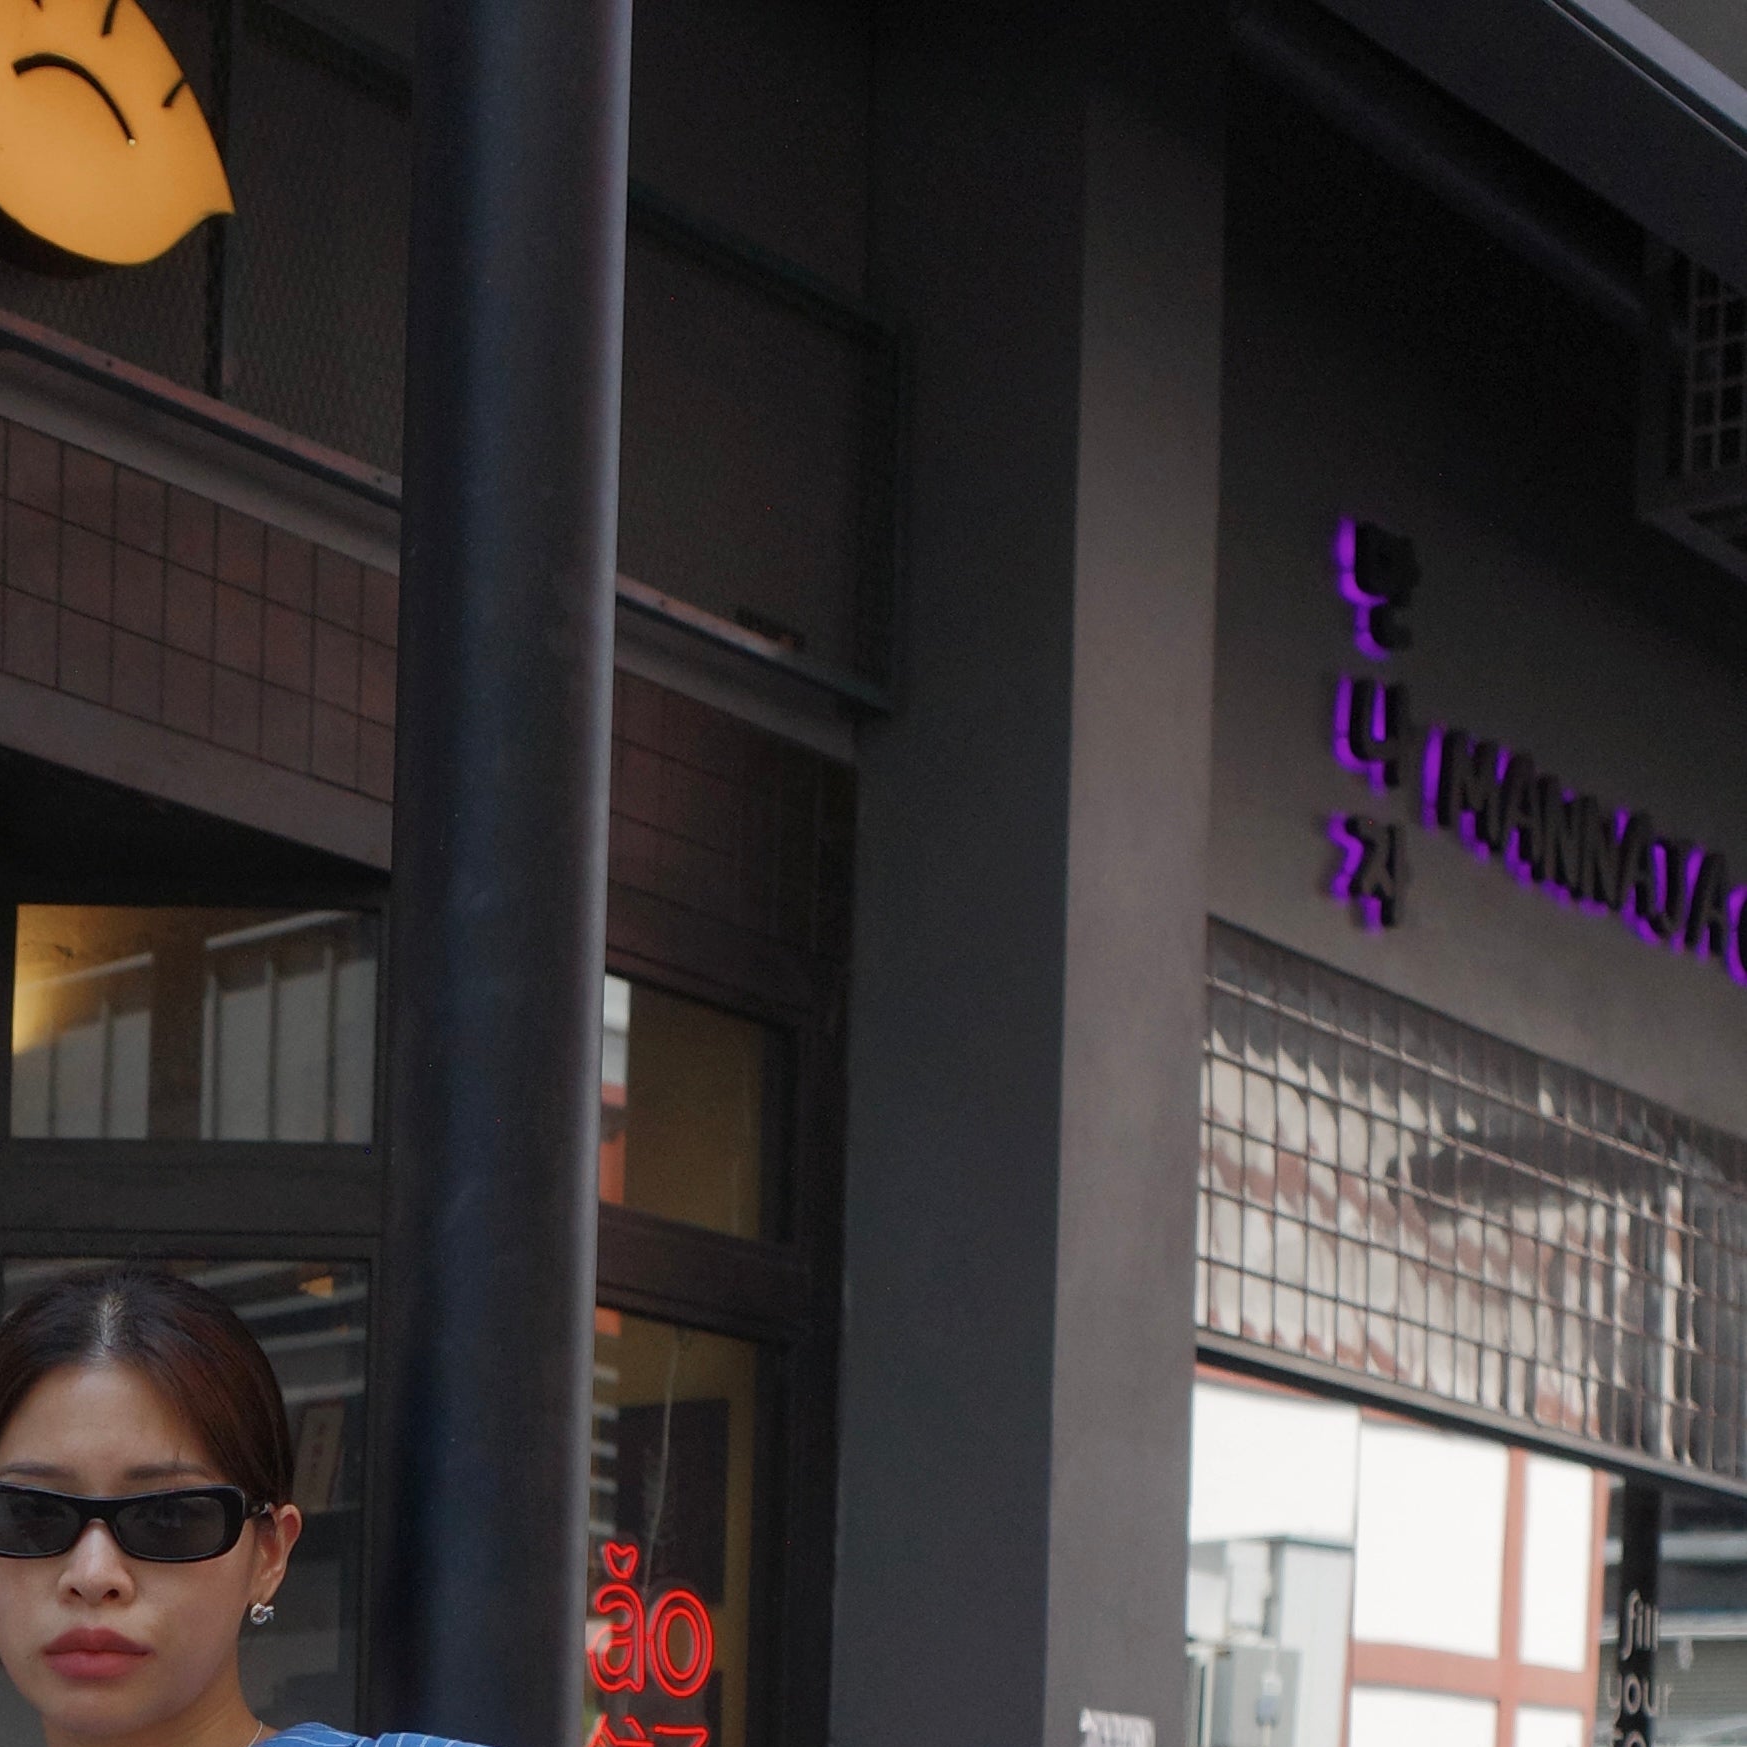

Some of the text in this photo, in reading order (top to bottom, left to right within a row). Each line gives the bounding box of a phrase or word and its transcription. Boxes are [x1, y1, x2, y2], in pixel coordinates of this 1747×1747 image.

[1422, 724, 1747, 985] MANNAJA
[1620, 1589, 1659, 1660] fill
[1606, 1673, 1674, 1725] your
